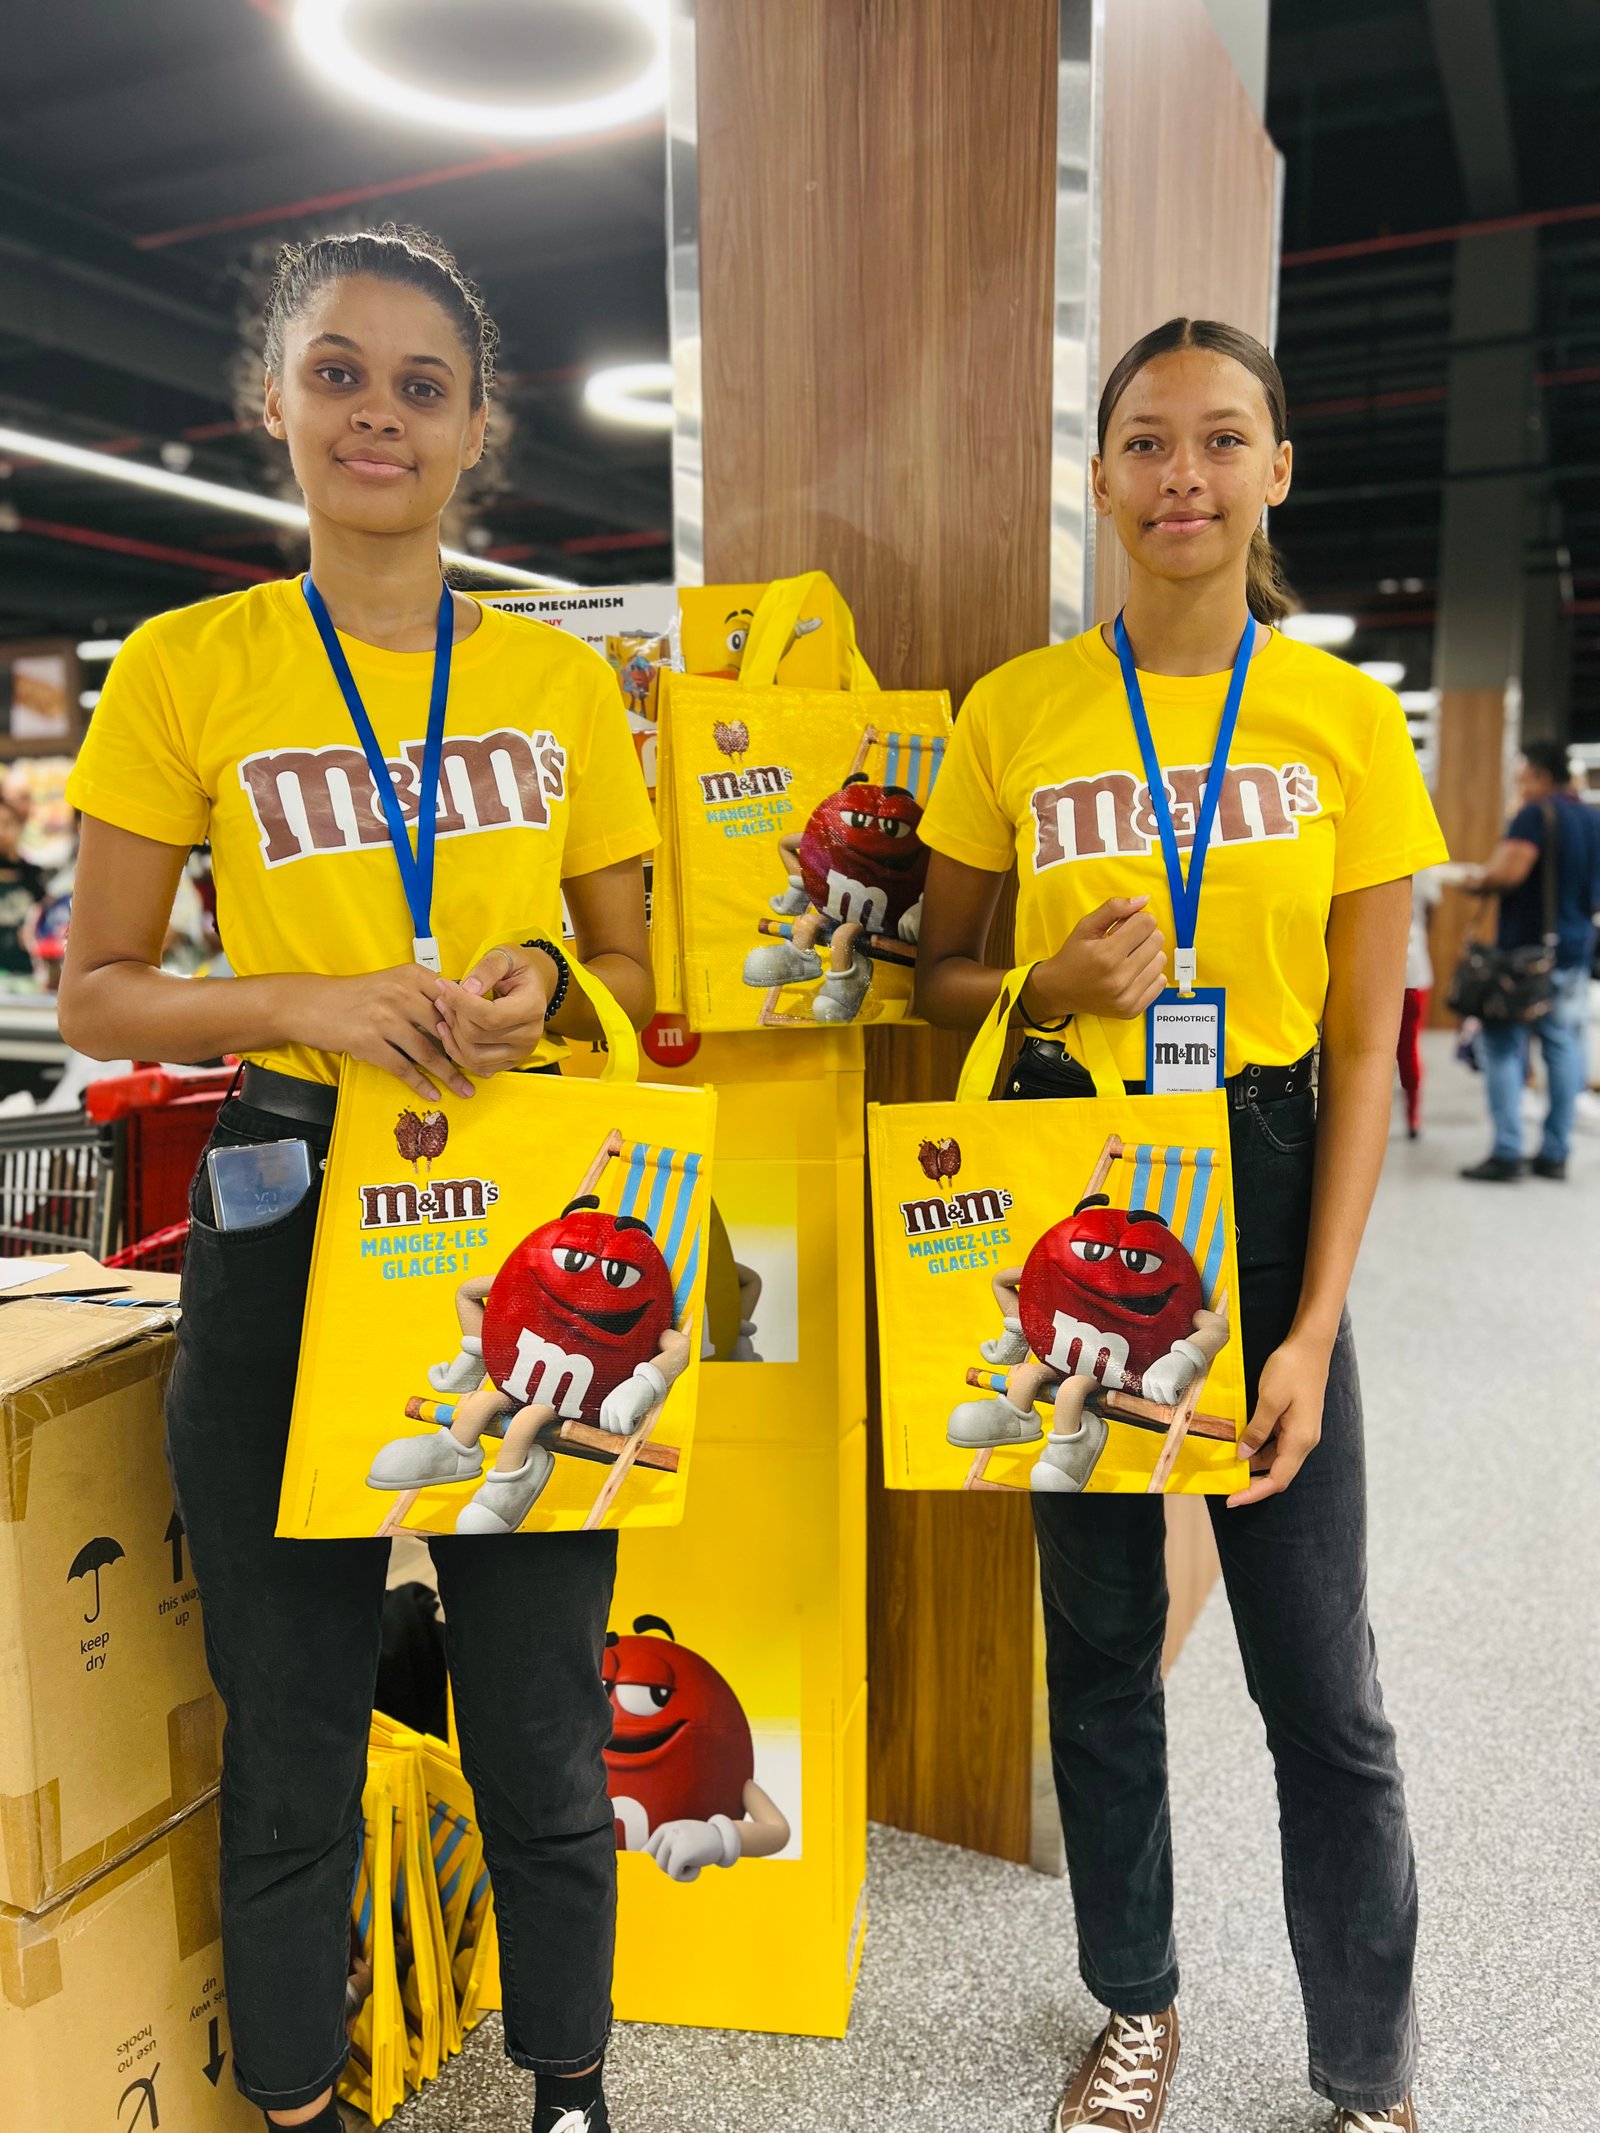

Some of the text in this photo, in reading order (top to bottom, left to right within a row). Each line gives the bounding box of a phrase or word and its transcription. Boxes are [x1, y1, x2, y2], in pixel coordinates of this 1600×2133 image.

[539, 597, 624, 612] MECHANISM
[706, 800, 793, 823] MANGEZ-LES
[1156, 1015, 1216, 1023] PROMOTRICE
[360, 1228, 489, 1258] MANGEZ-LES
[908, 1228, 1011, 1258] MANGEZ-LES
[382, 1252, 458, 1280] GLACÉS
[928, 1250, 989, 1274] GLACÉS
[158, 1596, 178, 1615] this
[175, 1611, 190, 1626] up
[80, 1632, 110, 1655] keep
[86, 1653, 107, 1672] dry
[202, 1977, 217, 1993] up
[189, 2000, 211, 2022] way
[116, 2024, 152, 2056] hooks
[118, 2040, 157, 2073] use no
